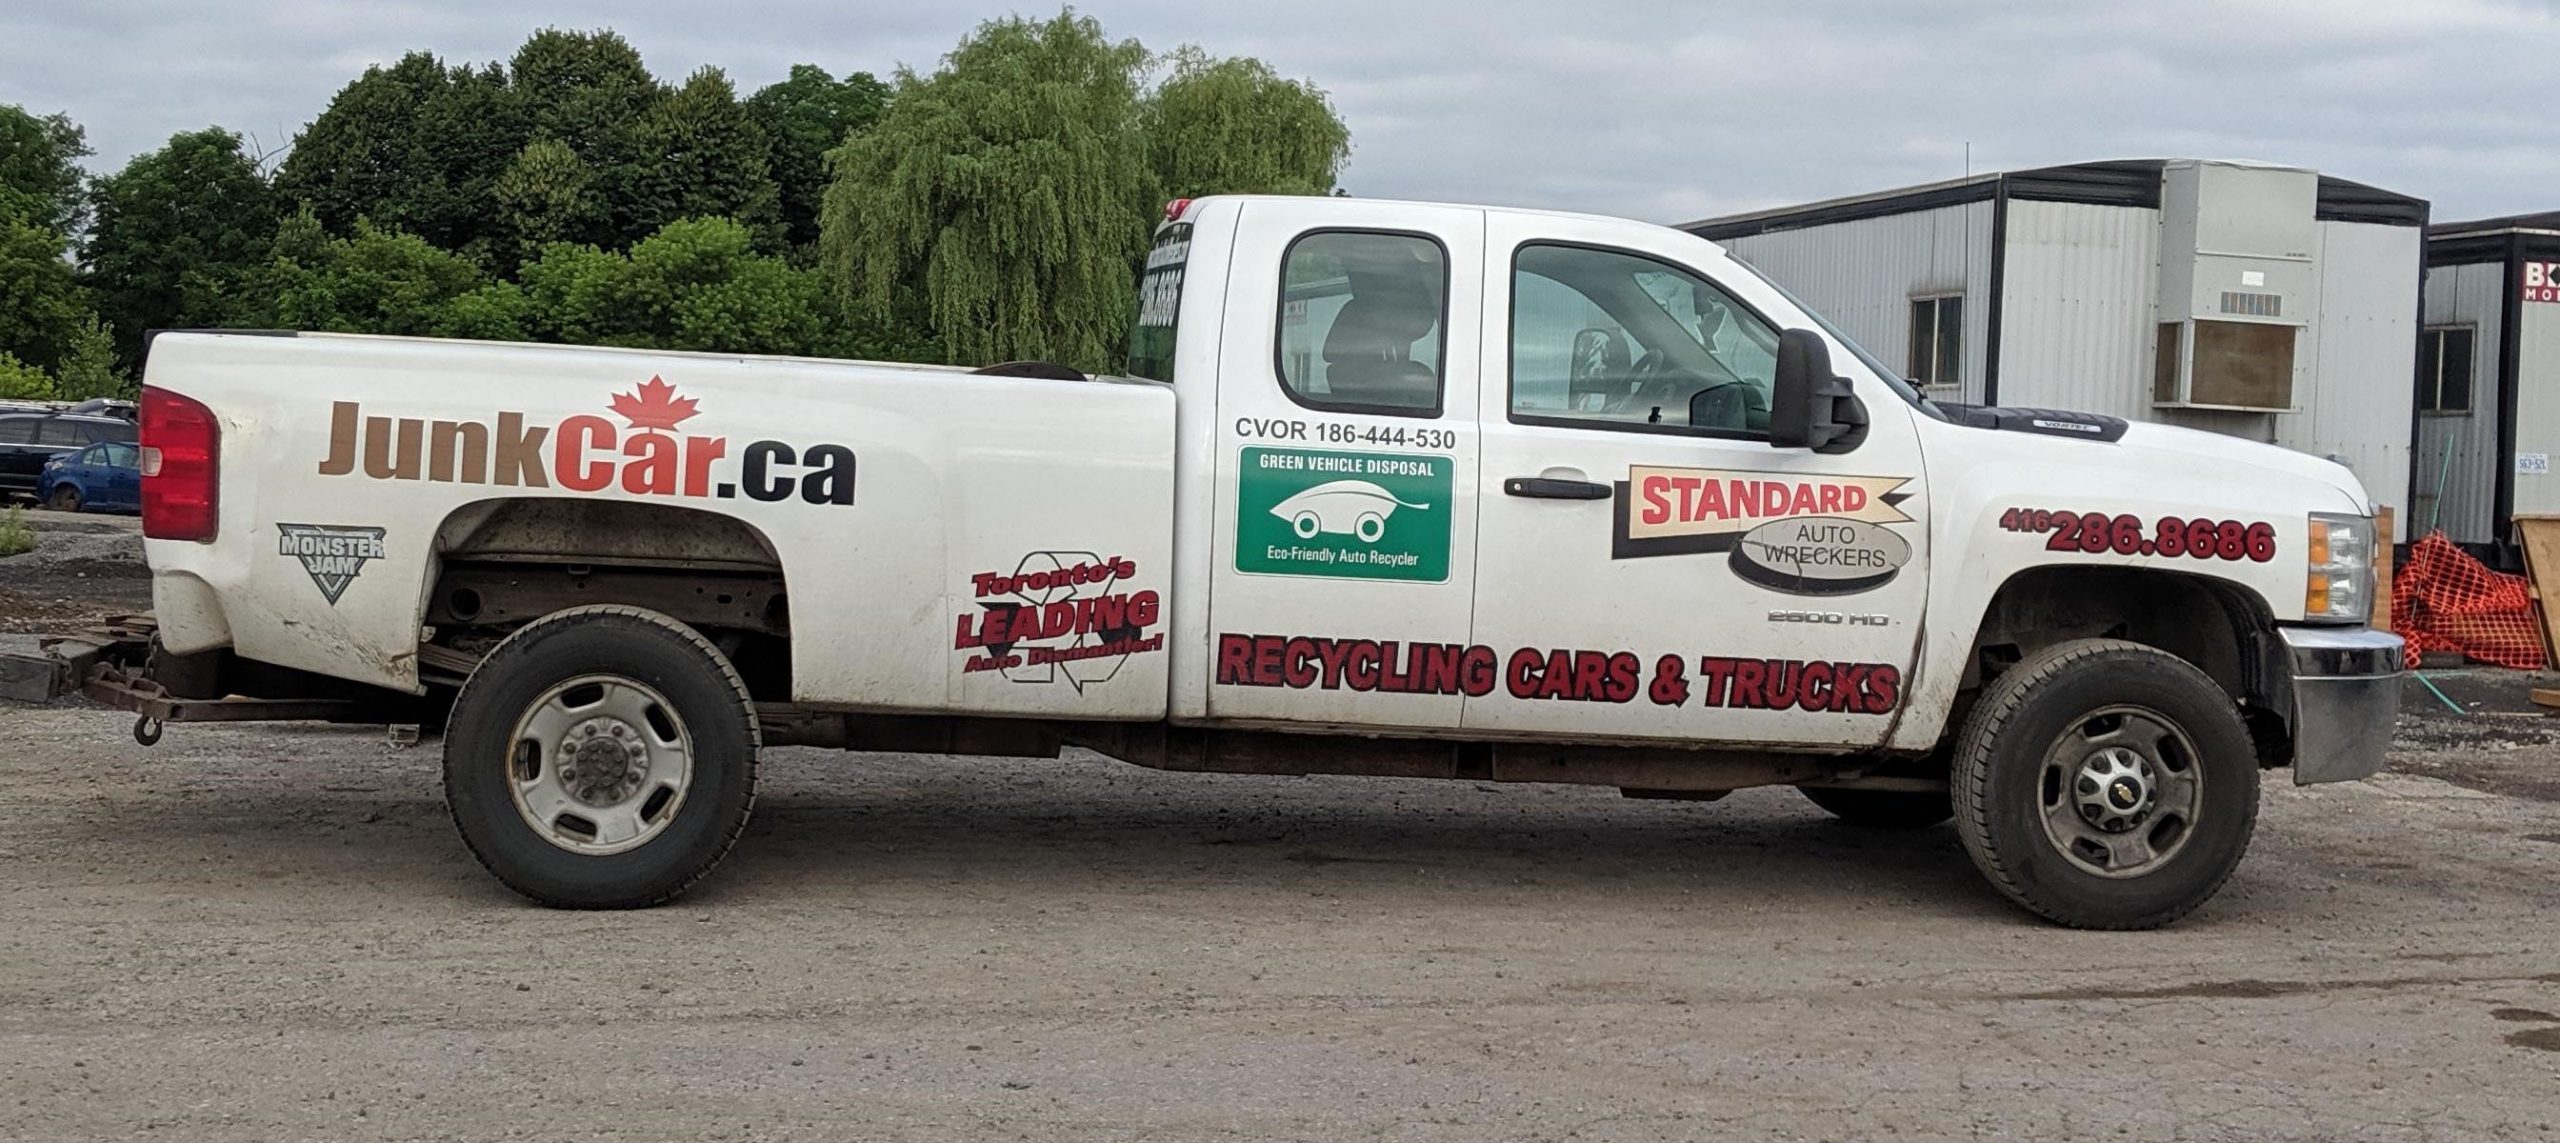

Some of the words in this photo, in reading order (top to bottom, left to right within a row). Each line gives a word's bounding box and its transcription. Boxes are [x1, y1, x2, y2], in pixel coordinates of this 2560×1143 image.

[2525, 288, 2560, 301] MO
[1236, 417, 1307, 440] CVOR
[1316, 422, 1456, 449] 186-444-530
[318, 400, 857, 506] JunkCar.ca
[1260, 454, 1303, 470] GREEN
[1308, 457, 1362, 473] VEHICLE
[1367, 460, 1434, 476] DISPOSAL
[1642, 475, 1868, 525] STANDARD
[1796, 524, 1856, 544] AUTO
[281, 535, 384, 558] MONSTER
[1267, 545, 1335, 564] Eco-Friendly
[1339, 549, 1366, 563] Auto
[1370, 551, 1419, 567] Recycler
[1764, 545, 1886, 567] WRECKERS
[304, 556, 359, 575] JAM
[971, 556, 1136, 598] Toronto's
[955, 590, 1160, 649] LEADING
[1768, 609, 1843, 624] 2500
[1849, 612, 1889, 626] HD
[963, 655, 1023, 674] Auto
[1216, 633, 1498, 697] RECYCLING
[1506, 647, 1640, 704] CARS
[1649, 655, 1690, 707] &
[1701, 656, 1901, 715] TRUCKS
